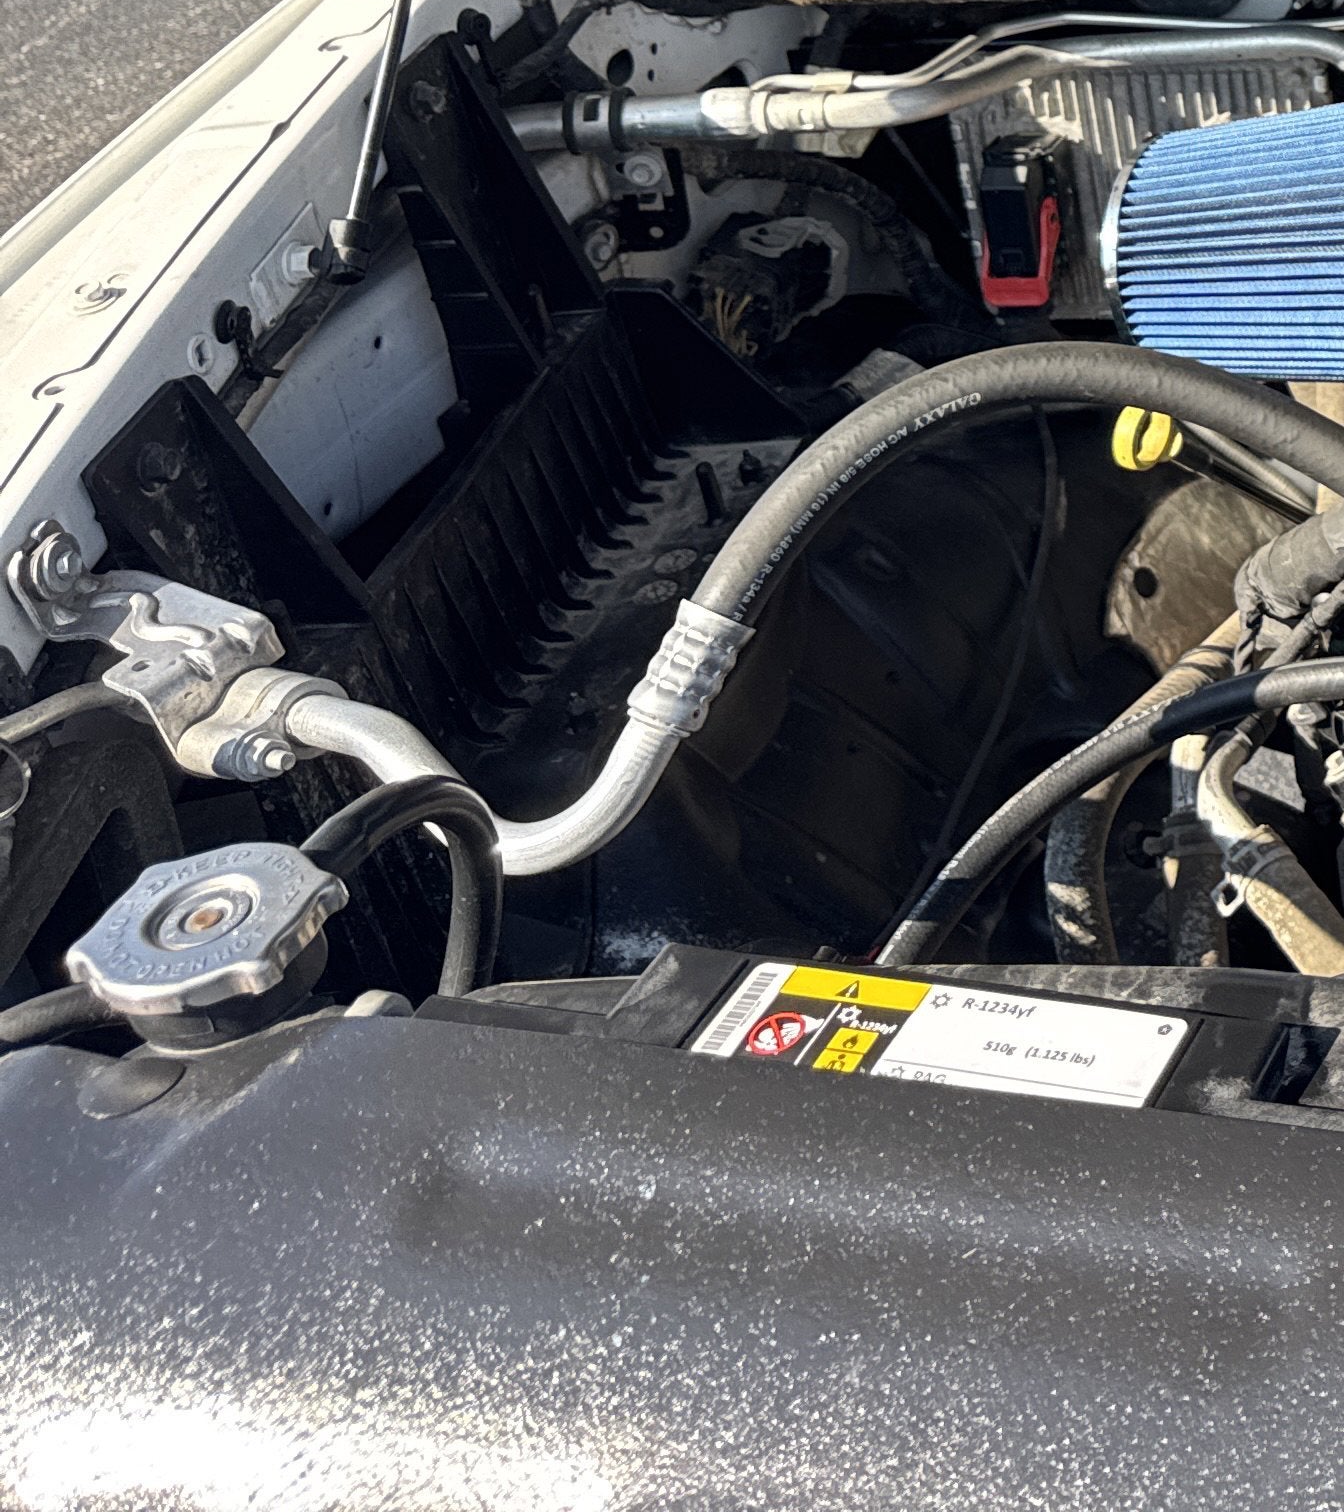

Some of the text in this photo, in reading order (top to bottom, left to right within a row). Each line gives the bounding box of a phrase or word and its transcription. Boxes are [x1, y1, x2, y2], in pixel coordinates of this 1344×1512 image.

[913, 392, 982, 432] GALAXY
[887, 426, 908, 444] A/C
[854, 442, 889, 470] HOSE
[826, 480, 841, 496] IN
[838, 466, 857, 483] 5/8
[811, 492, 829, 512] (16
[790, 509, 814, 534] MM)
[770, 534, 793, 562] 4860
[742, 563, 775, 604] R-134a
[172, 850, 250, 881] KEEP
[136, 955, 208, 979] OPEN
[213, 926, 265, 962] HOT
[961, 997, 1037, 1019] R-1234yf
[982, 1040, 1097, 1068] 510g (1.125 lbs)
